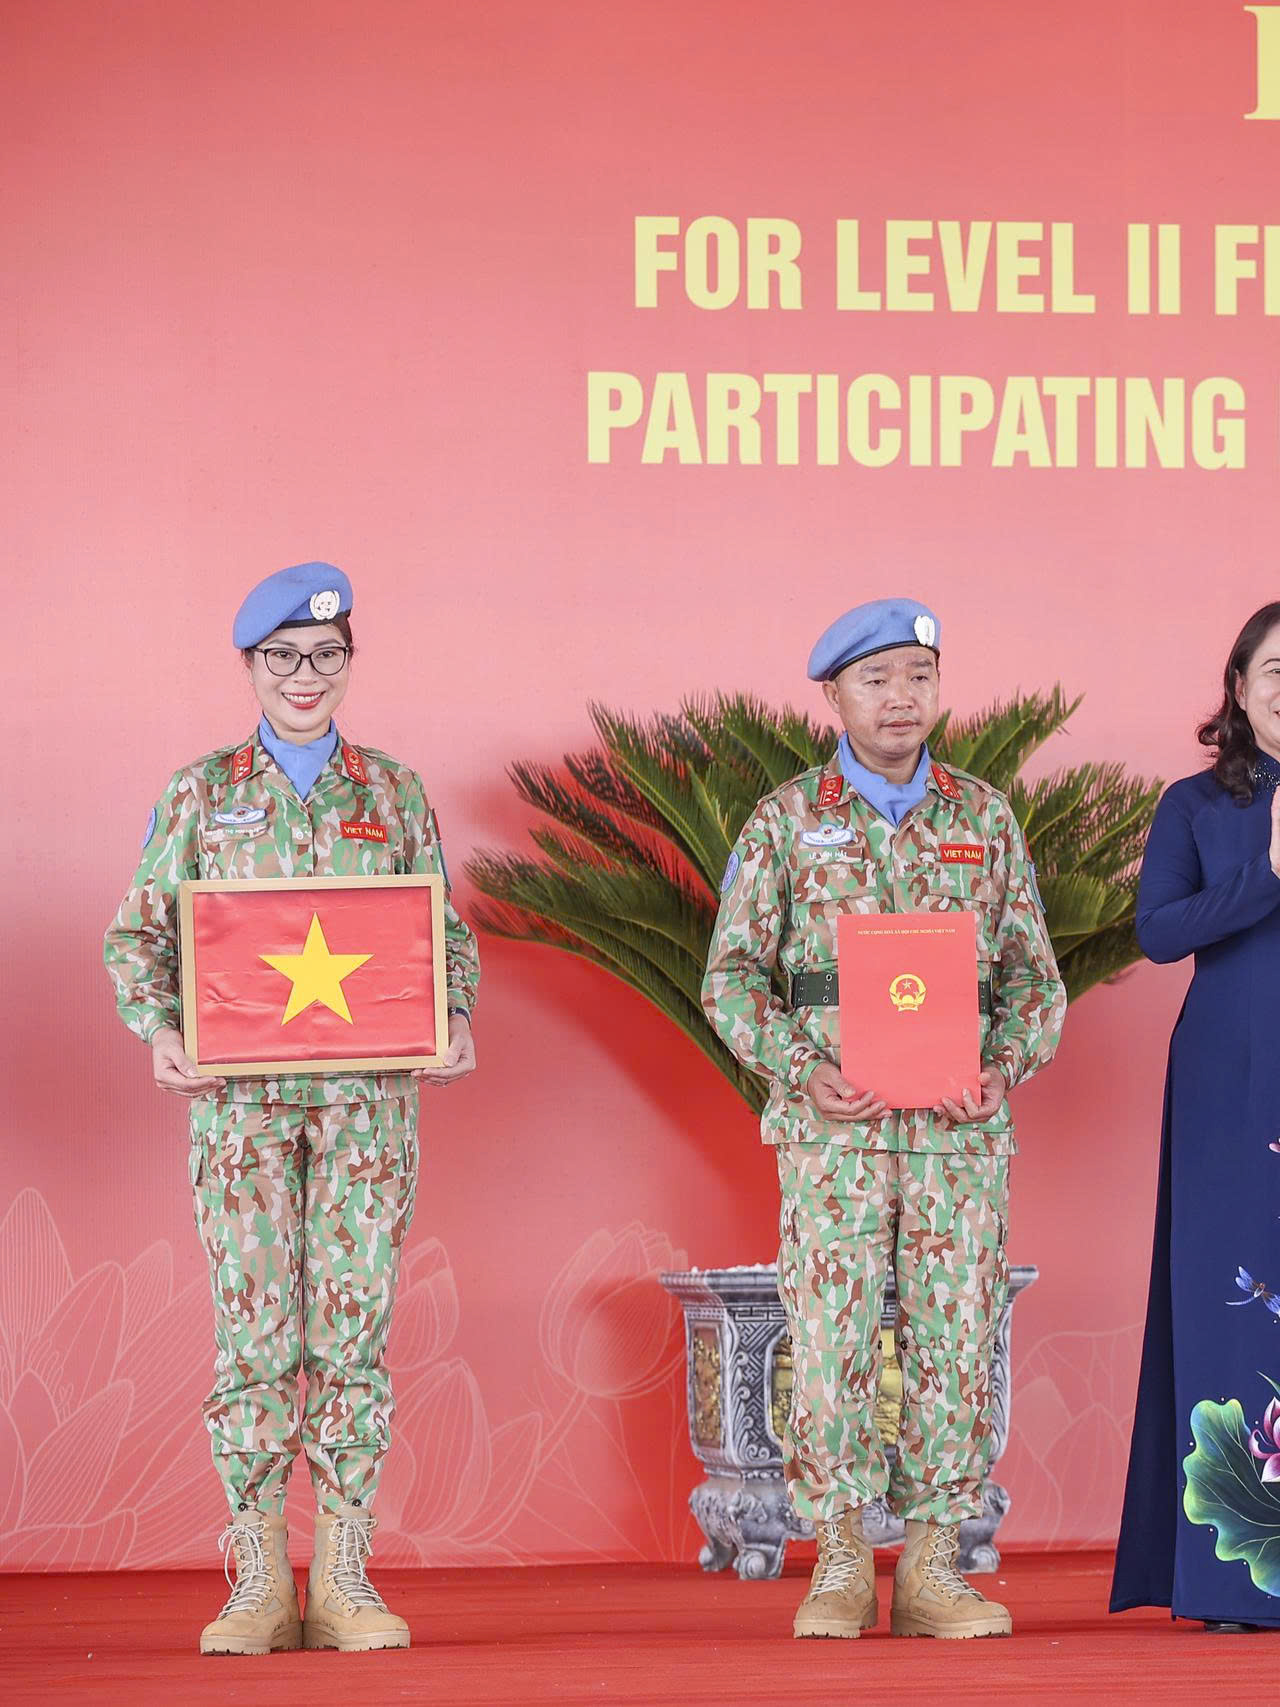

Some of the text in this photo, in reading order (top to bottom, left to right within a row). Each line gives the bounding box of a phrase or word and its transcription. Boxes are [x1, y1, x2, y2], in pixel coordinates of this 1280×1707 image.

[634, 214, 803, 310] FOR
[836, 219, 1096, 313] LEVEL
[1127, 223, 1181, 315] II
[587, 371, 1246, 470] PARTICIPATING
[364, 826, 384, 839] NAM
[964, 850, 982, 860] NAM
